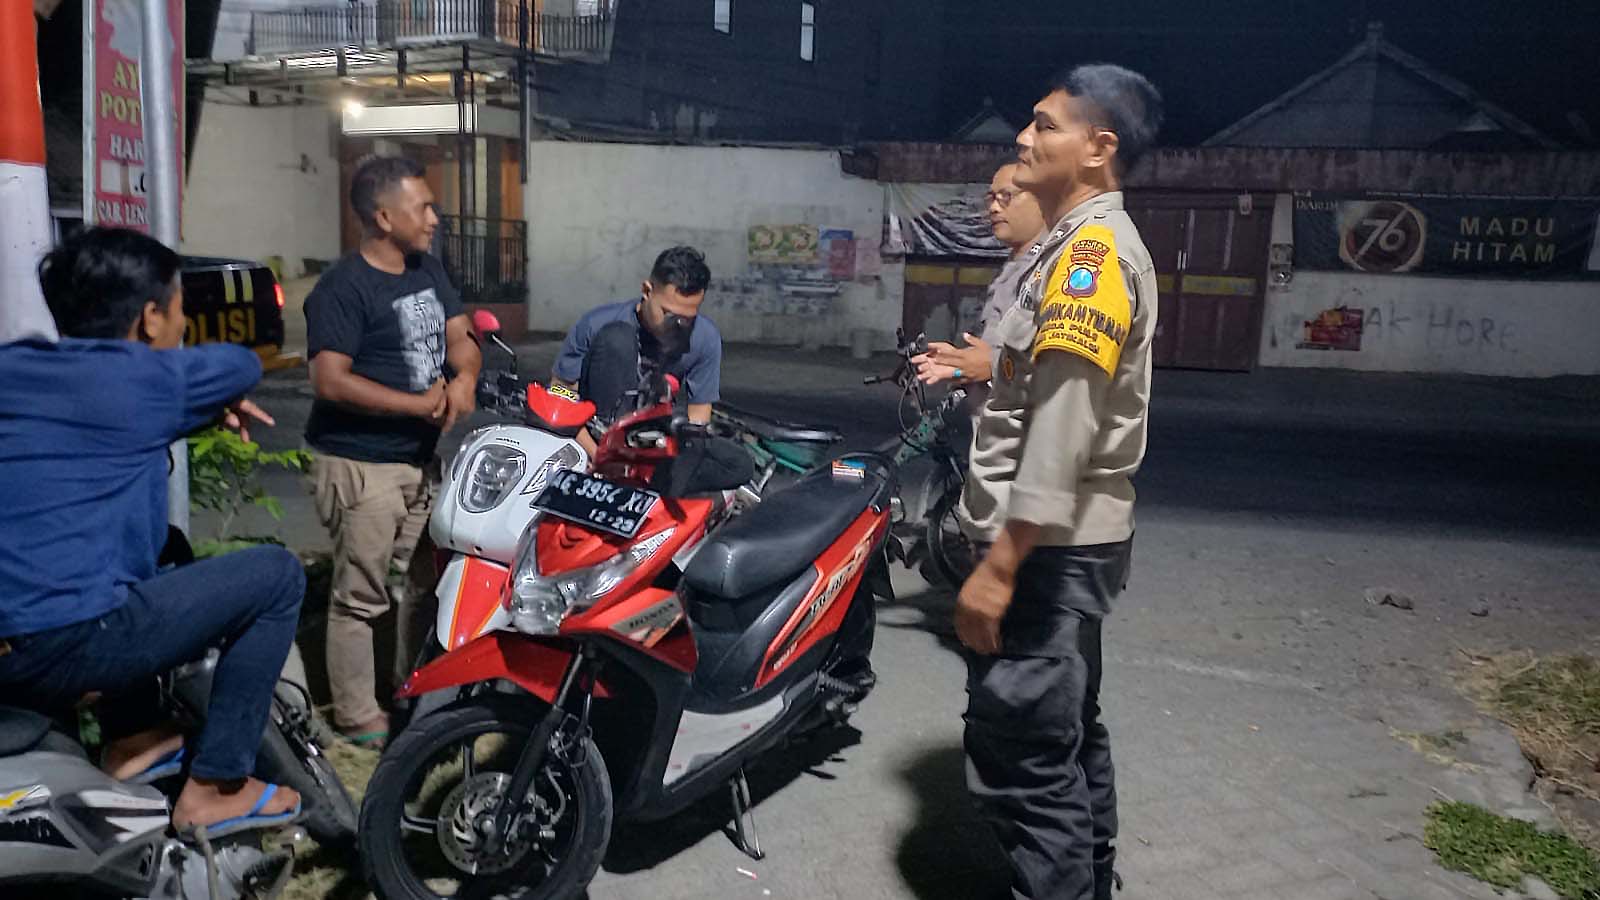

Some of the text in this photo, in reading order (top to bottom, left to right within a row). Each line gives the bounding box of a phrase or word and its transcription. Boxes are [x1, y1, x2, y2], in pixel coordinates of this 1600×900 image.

[113, 61, 139, 91] AY
[100, 90, 141, 126] POT
[110, 133, 144, 161] HAR
[1352, 205, 1410, 260] 76
[1460, 216, 1556, 237] MADU
[1452, 240, 1557, 263] HITAM
[185, 306, 256, 346] OLISI
[575, 478, 624, 504] 3954
